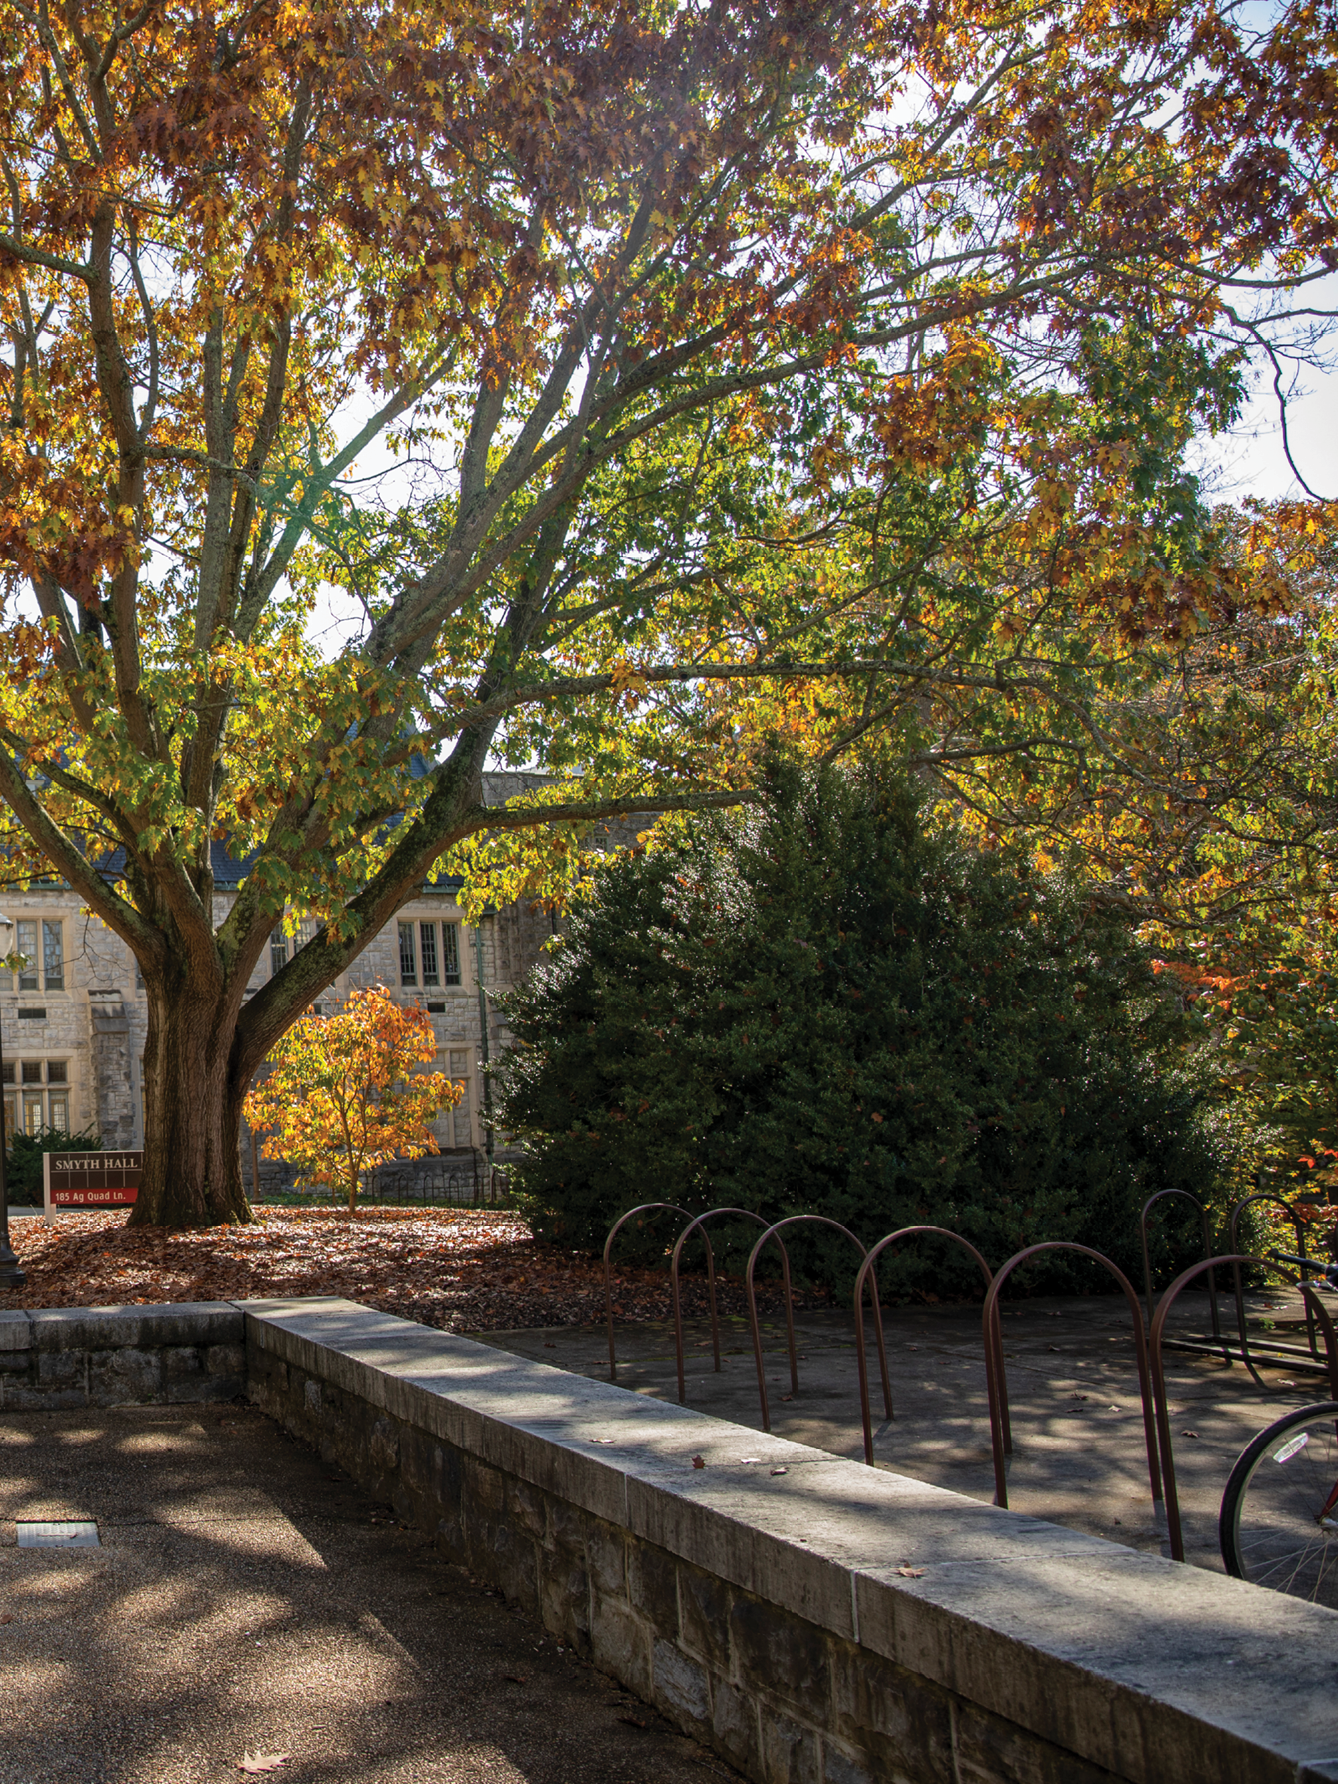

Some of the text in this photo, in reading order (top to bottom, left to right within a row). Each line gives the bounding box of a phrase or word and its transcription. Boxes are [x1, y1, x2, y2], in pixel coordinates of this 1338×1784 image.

[55, 1159, 138, 1170] SMYTH HALL
[55, 1191, 126, 1203] 185 Ag Quad Ln.
